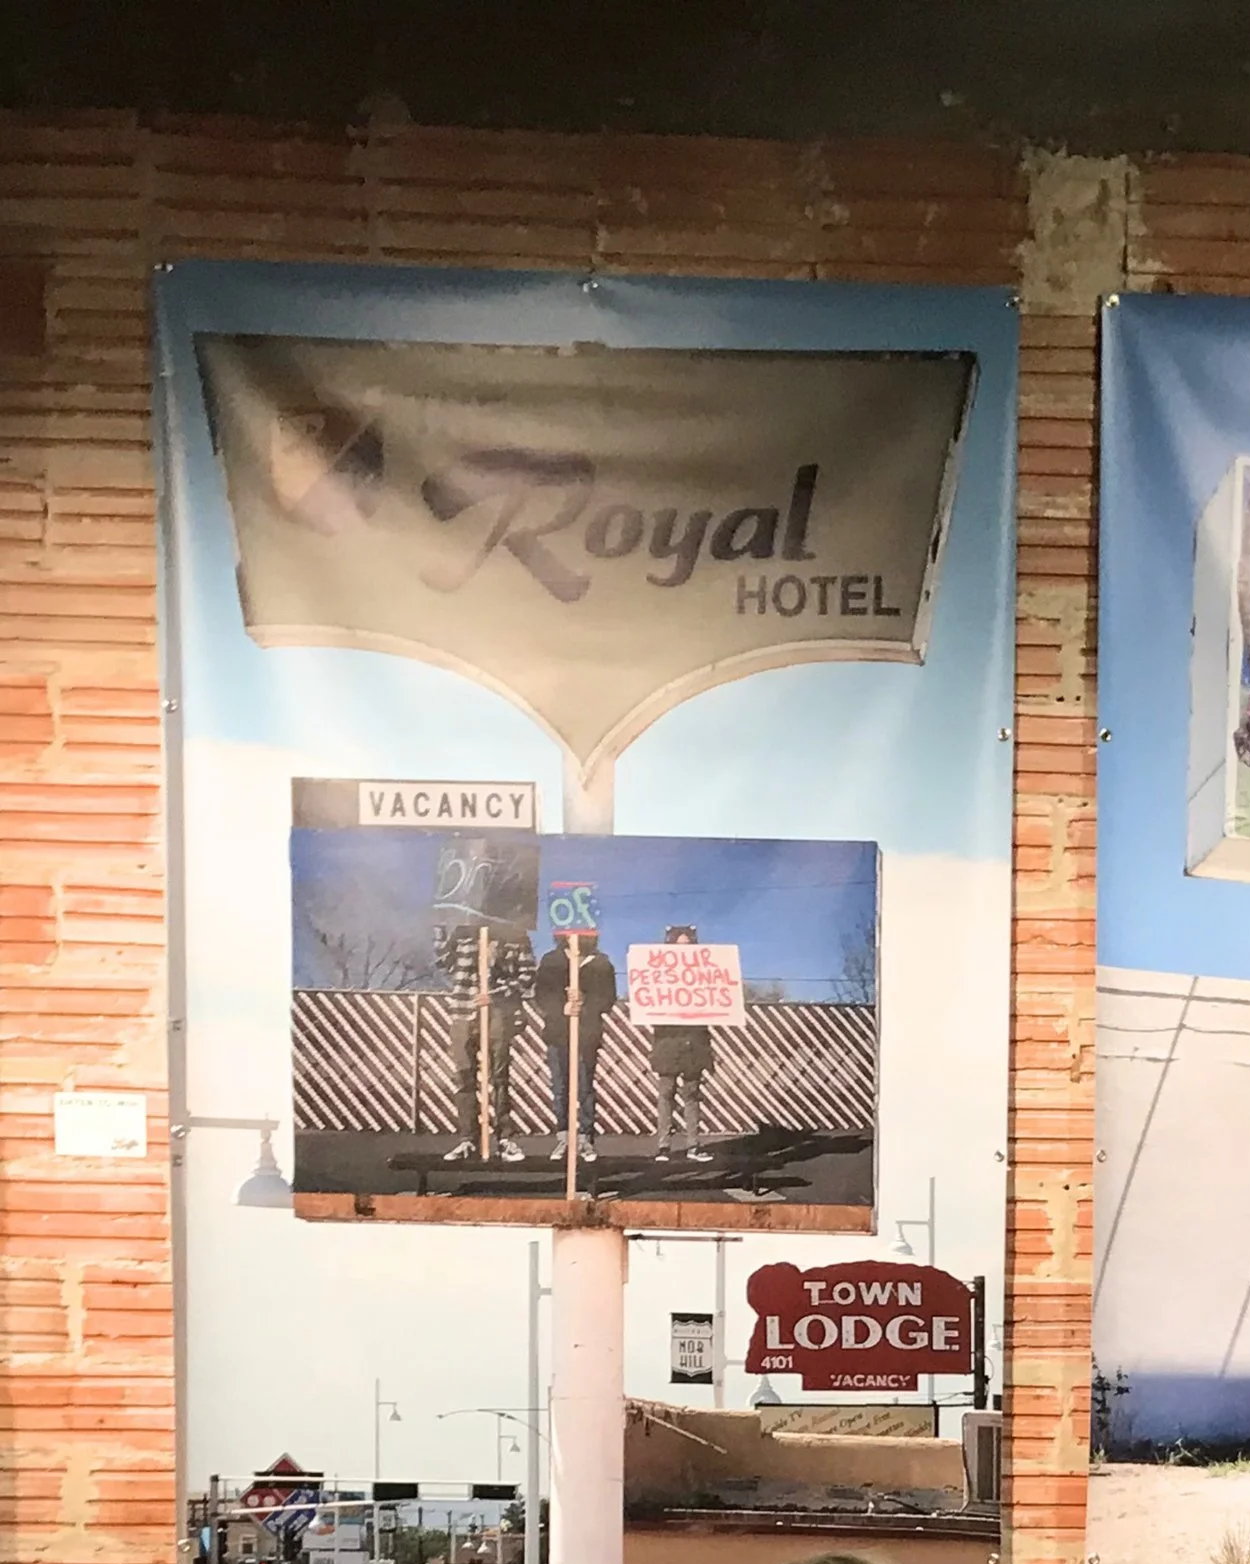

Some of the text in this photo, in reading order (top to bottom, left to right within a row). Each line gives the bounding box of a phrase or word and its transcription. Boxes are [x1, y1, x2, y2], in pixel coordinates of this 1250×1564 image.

[421, 448, 819, 602] Royal
[736, 573, 901, 617] HOTEL
[368, 790, 526, 820] VACANCY
[647, 948, 717, 971] YOUR
[629, 966, 738, 990] PERSONAL
[634, 985, 734, 1009] GHOSTS
[803, 1281, 922, 1306] TOWN
[766, 1315, 960, 1352] LODGE
[761, 1355, 793, 1369] 4101
[830, 1374, 911, 1388] VACANCY
